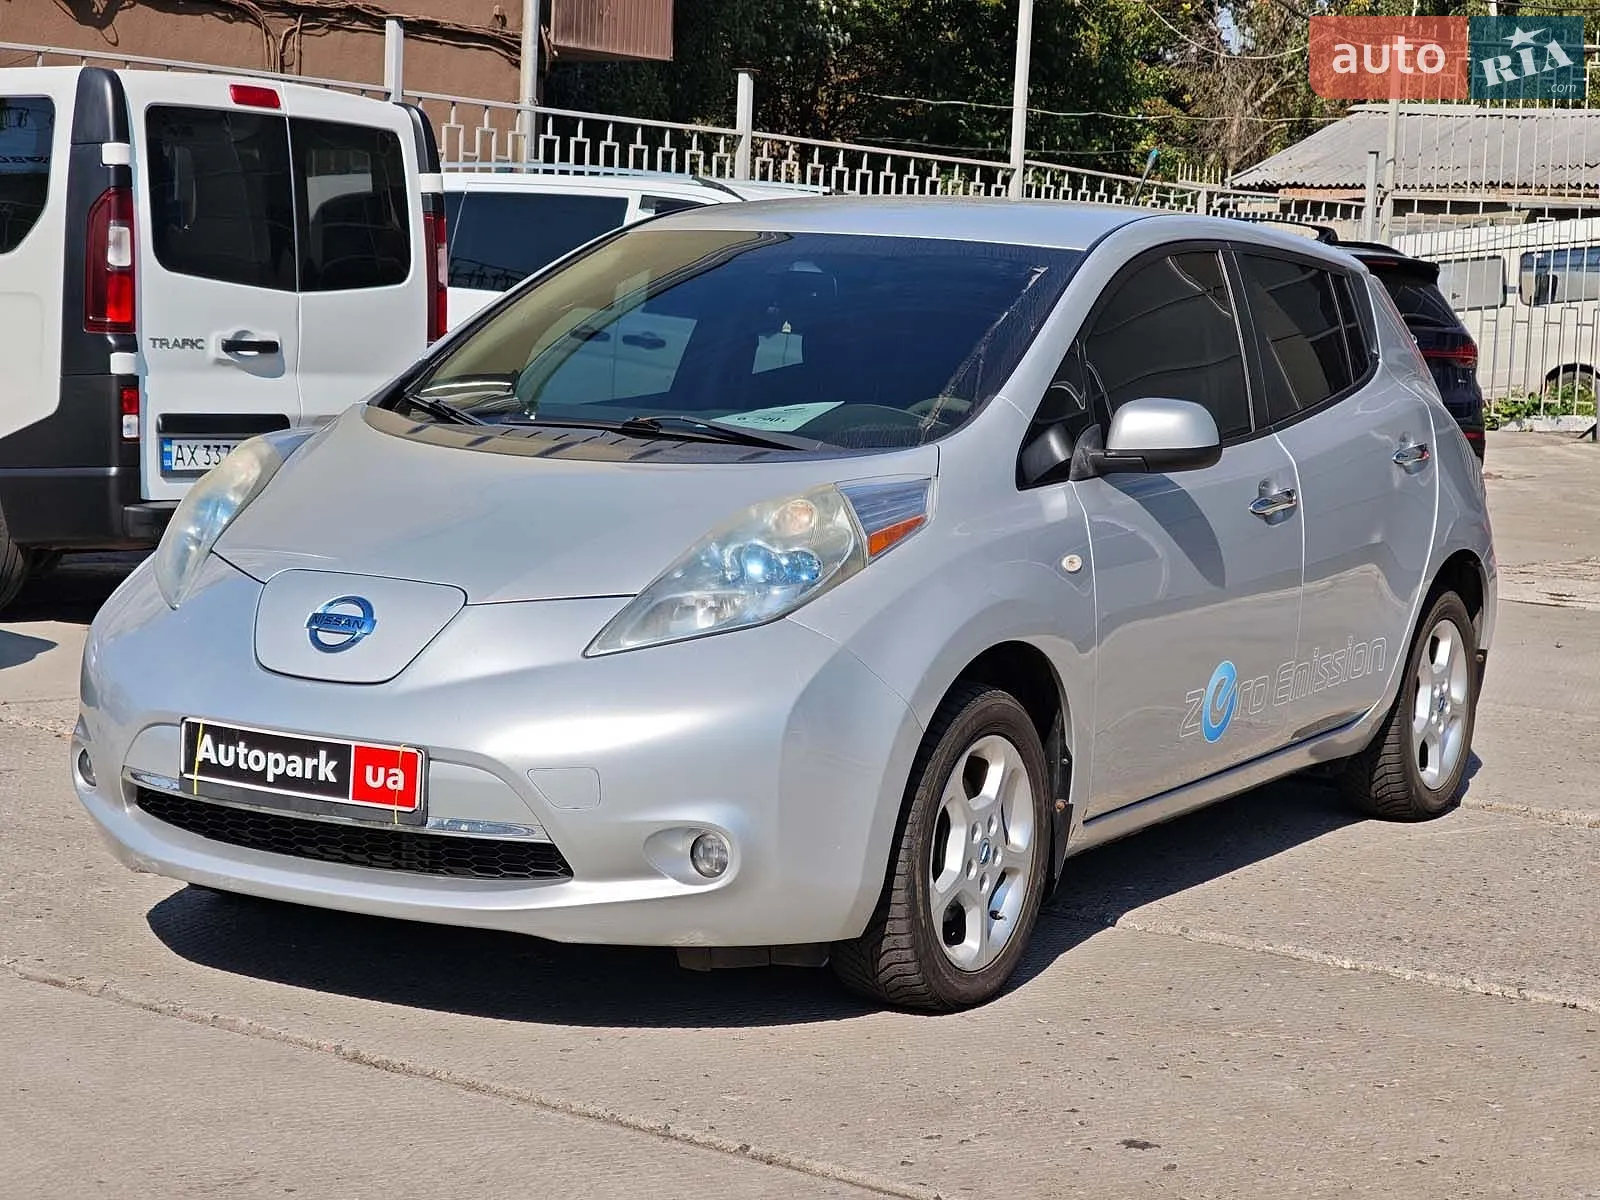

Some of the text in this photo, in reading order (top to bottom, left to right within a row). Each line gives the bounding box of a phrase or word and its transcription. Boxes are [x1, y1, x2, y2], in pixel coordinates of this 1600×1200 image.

[174, 444, 237, 466] AX 337
[310, 615, 365, 630] NISSAN
[1273, 635, 1387, 707] Emission
[197, 734, 405, 791] Autopark ua
